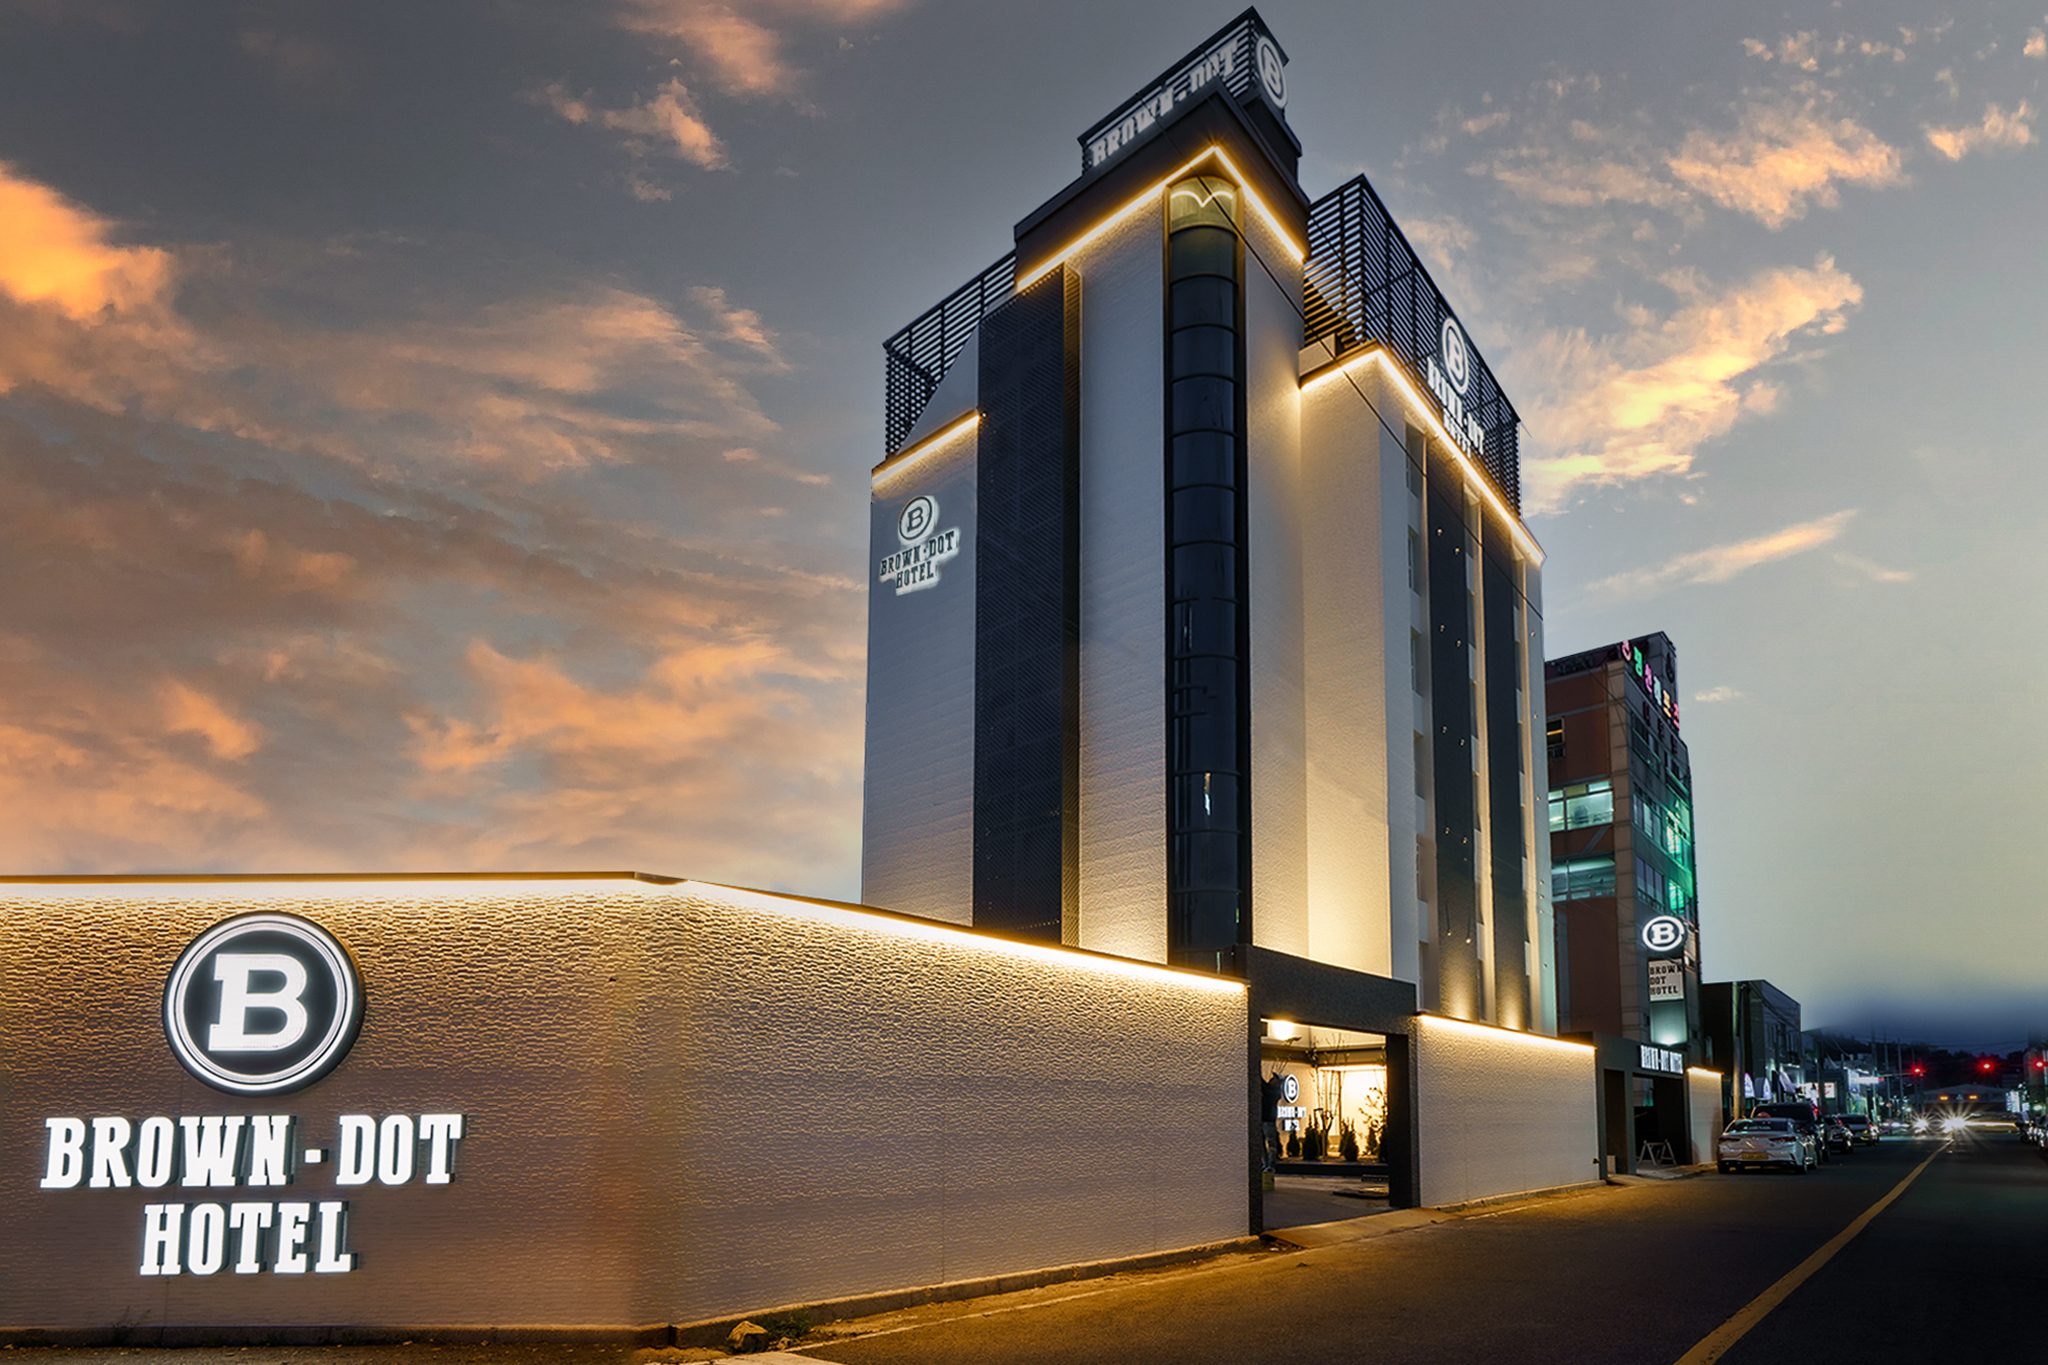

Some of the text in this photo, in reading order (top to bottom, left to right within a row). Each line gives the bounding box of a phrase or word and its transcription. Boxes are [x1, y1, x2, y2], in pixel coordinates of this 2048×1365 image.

[1264, 45, 1281, 93] B
[1448, 328, 1463, 381] B
[907, 507, 923, 532] B
[896, 561, 934, 588] HOTEL
[1651, 923, 1675, 945] B
[208, 953, 307, 1051] B
[1288, 1079, 1296, 1097] B
[139, 1201, 353, 1276] HOTEL
